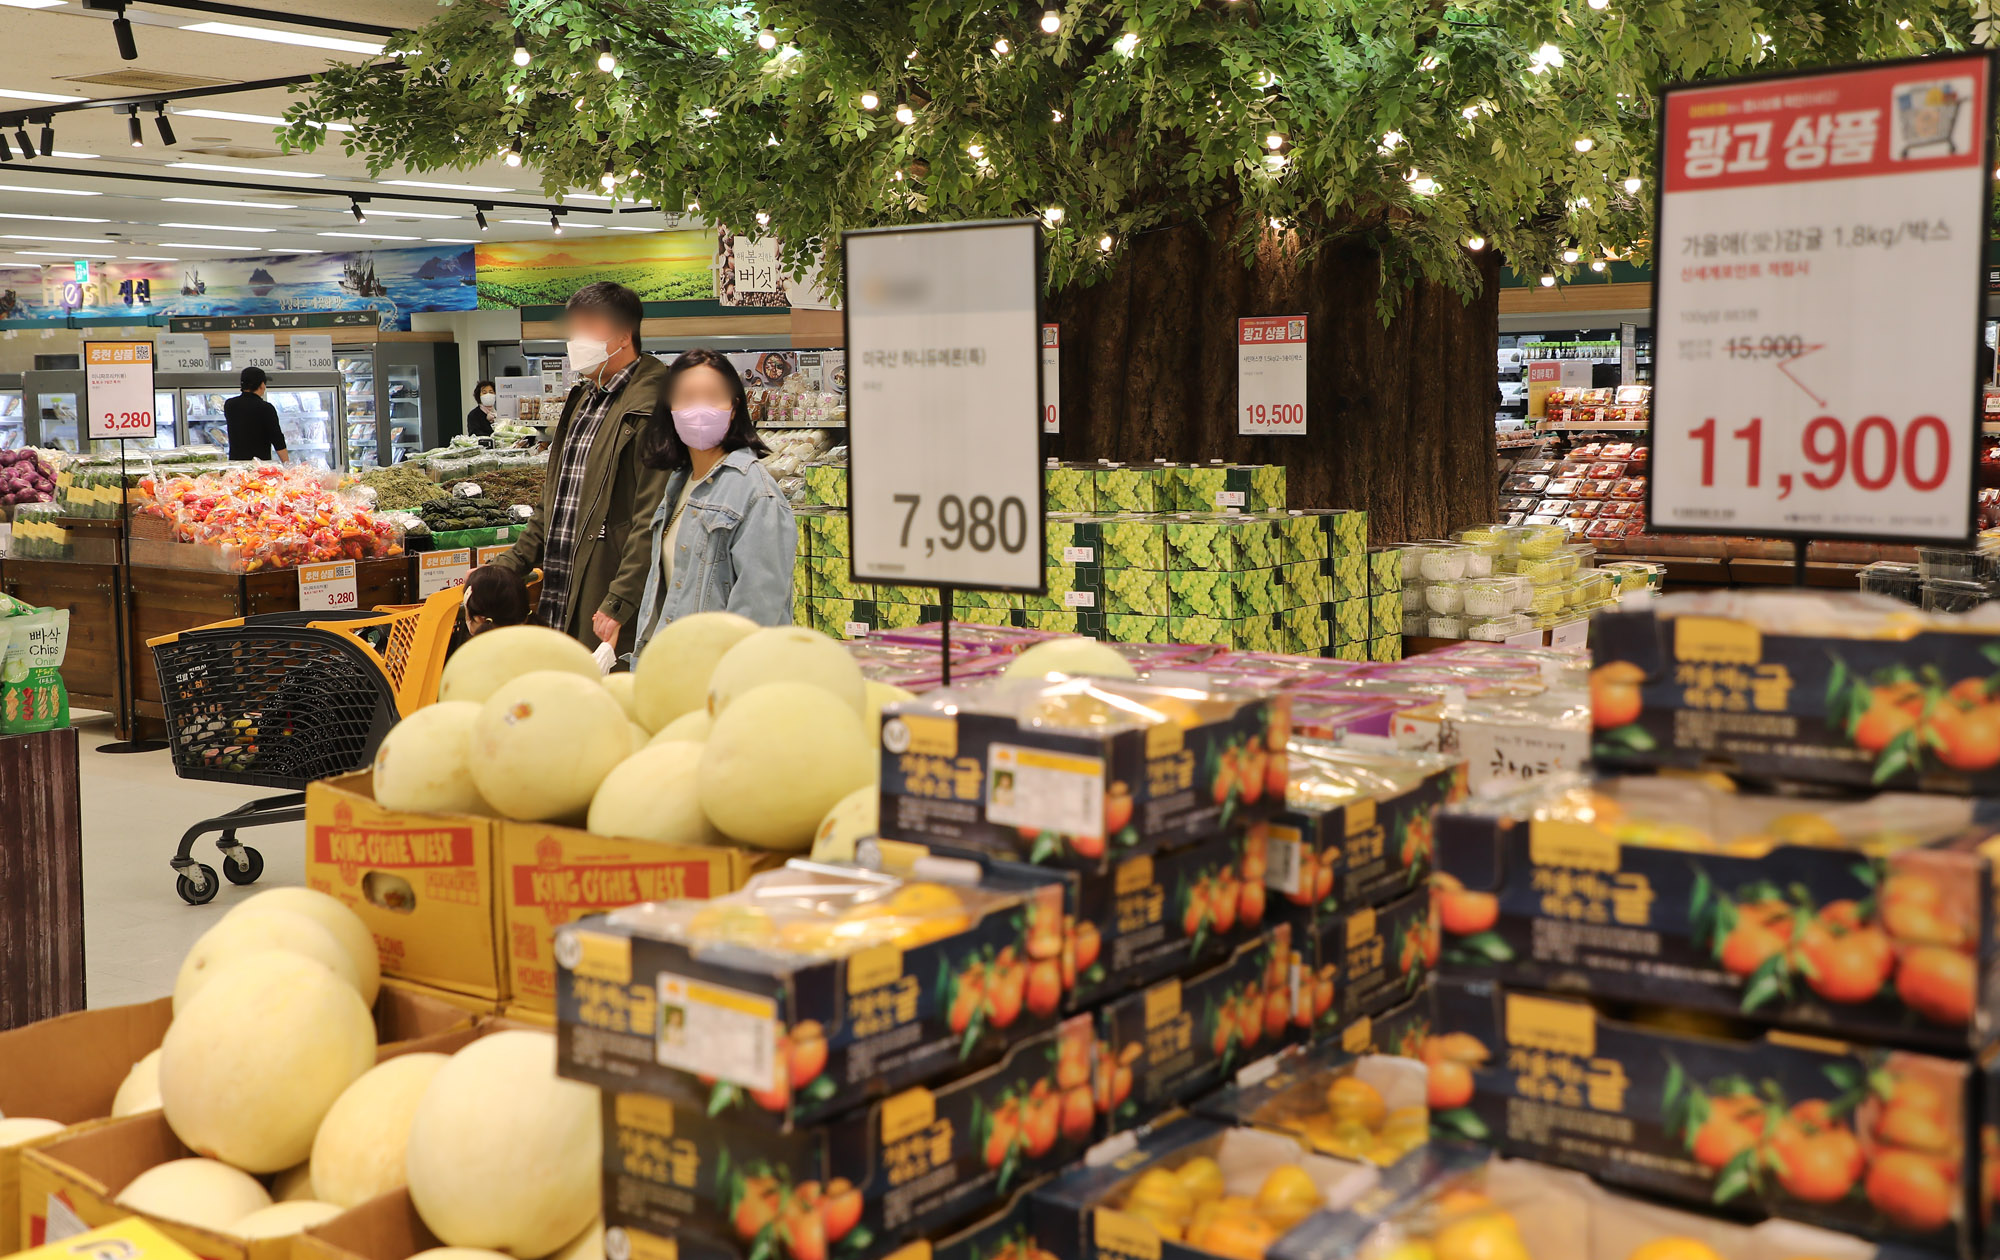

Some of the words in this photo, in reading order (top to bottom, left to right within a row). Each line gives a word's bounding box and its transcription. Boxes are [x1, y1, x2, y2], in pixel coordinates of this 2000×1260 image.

[1684, 122, 1773, 179] 광고
[1784, 109, 1880, 170] 상품
[41, 264, 113, 306] fresh
[739, 265, 772, 289] 버섯
[118, 279, 151, 307] 생선
[1244, 327, 1263, 341] 광고
[1265, 326, 1286, 340] 상품
[91, 349, 111, 361] 추천
[113, 349, 133, 361] 상품
[1726, 335, 1803, 361] 15,900
[249, 359, 273, 367] 13,800
[308, 359, 331, 367] 13,800
[104, 412, 151, 430] 3,280
[1246, 404, 1303, 426] 19,500
[1688, 415, 1951, 501] 11,900
[894, 494, 1027, 558] 7,980
[426, 557, 438, 567] 추천
[305, 570, 318, 582] 추천
[320, 568, 334, 580] 상품
[328, 591, 354, 605] 3,280
[29, 627, 60, 644] 빠삭
[29, 645, 58, 656] Chips
[330, 833, 366, 863] KING
[408, 832, 453, 864] WEST
[531, 869, 580, 902] KING
[633, 866, 687, 902] WEST
